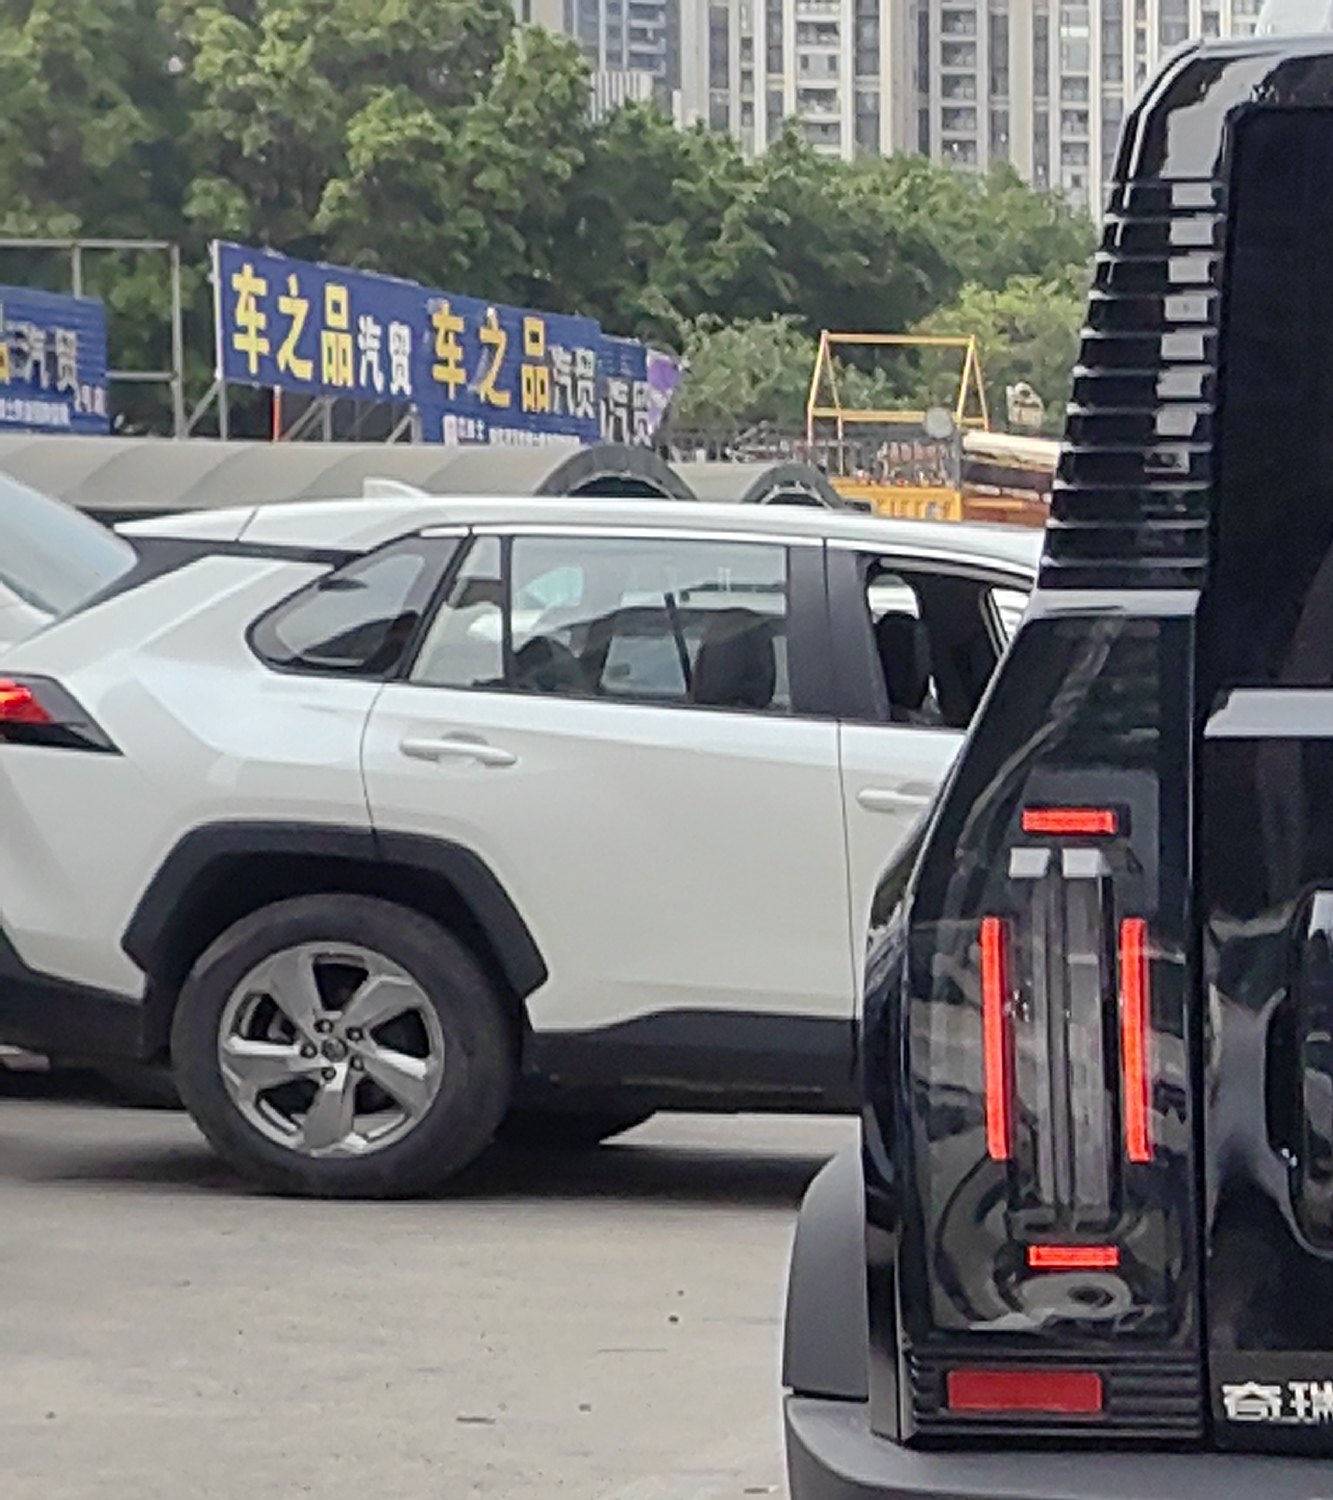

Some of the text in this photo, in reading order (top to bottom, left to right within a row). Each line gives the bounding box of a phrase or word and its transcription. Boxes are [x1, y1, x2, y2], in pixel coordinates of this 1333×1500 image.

[231, 262, 412, 396] 车之品汽贸
[431, 300, 597, 420] 车之品汽贸
